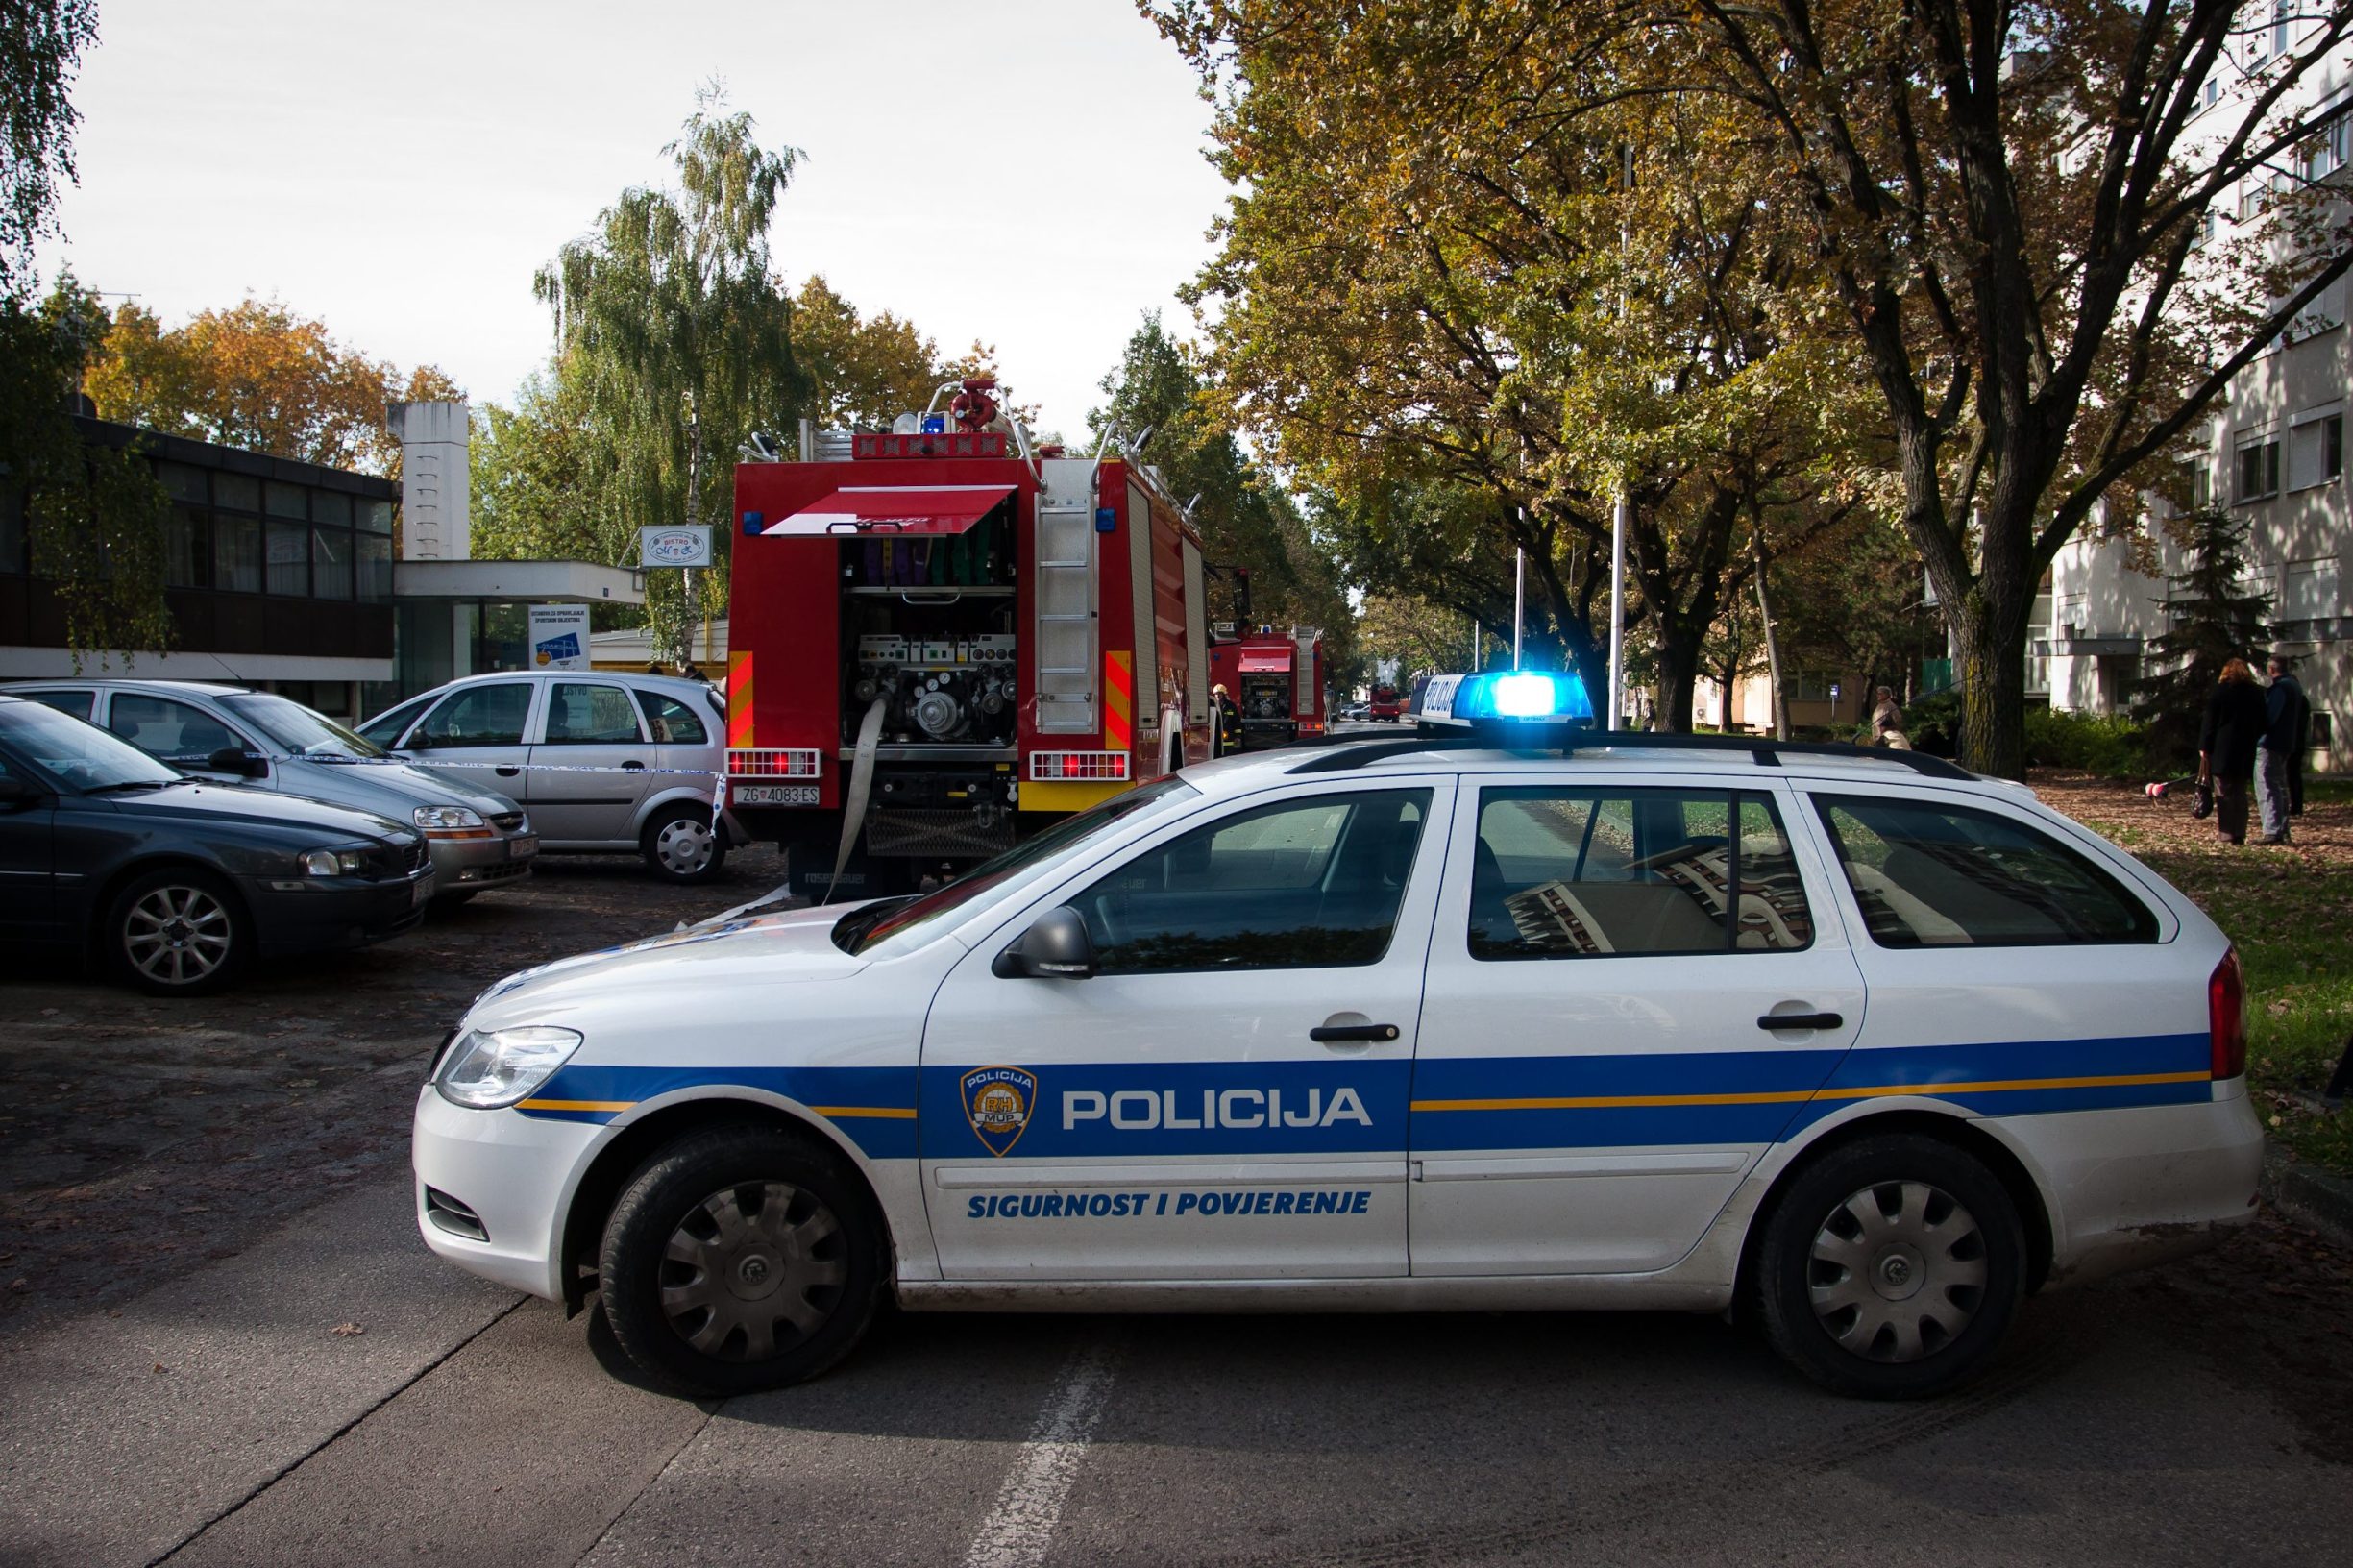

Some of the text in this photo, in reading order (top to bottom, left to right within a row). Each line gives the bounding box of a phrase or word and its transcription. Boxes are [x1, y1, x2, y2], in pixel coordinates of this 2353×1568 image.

[743, 788, 818, 802] ZG 4083-ES
[967, 1071, 1032, 1088] POLICIJA
[985, 1097, 1013, 1112] RH
[1063, 1088, 1373, 1130] POLICIJA
[968, 1191, 1372, 1218] SIGURNOST I POVJERENJE
